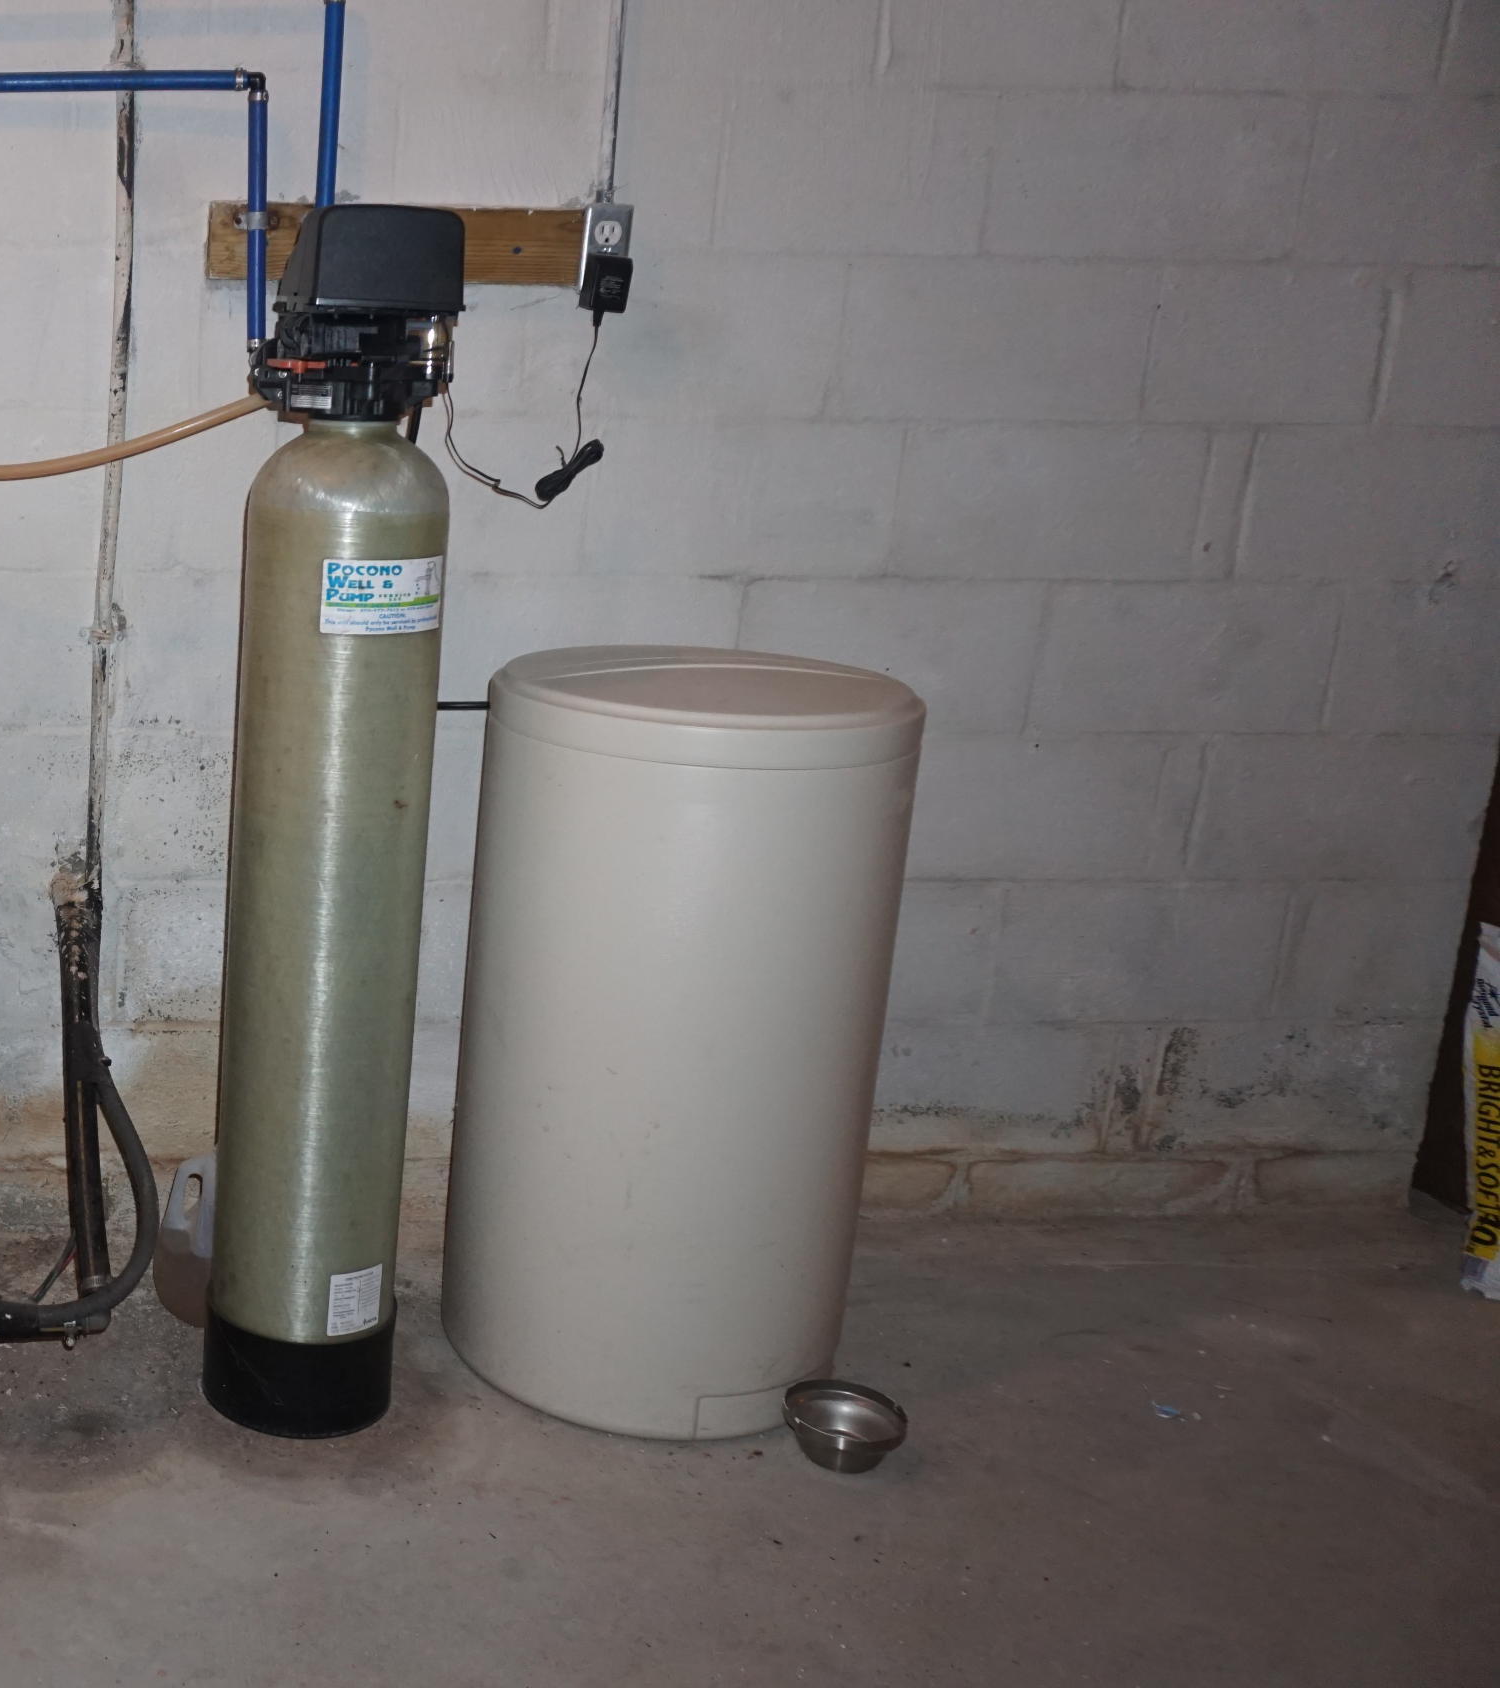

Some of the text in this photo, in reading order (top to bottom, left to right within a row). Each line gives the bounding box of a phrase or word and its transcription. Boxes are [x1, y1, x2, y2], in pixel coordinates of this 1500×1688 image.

[327, 562, 402, 576] POCONO
[327, 576, 393, 589] WELL &
[326, 589, 374, 602] PUMP
